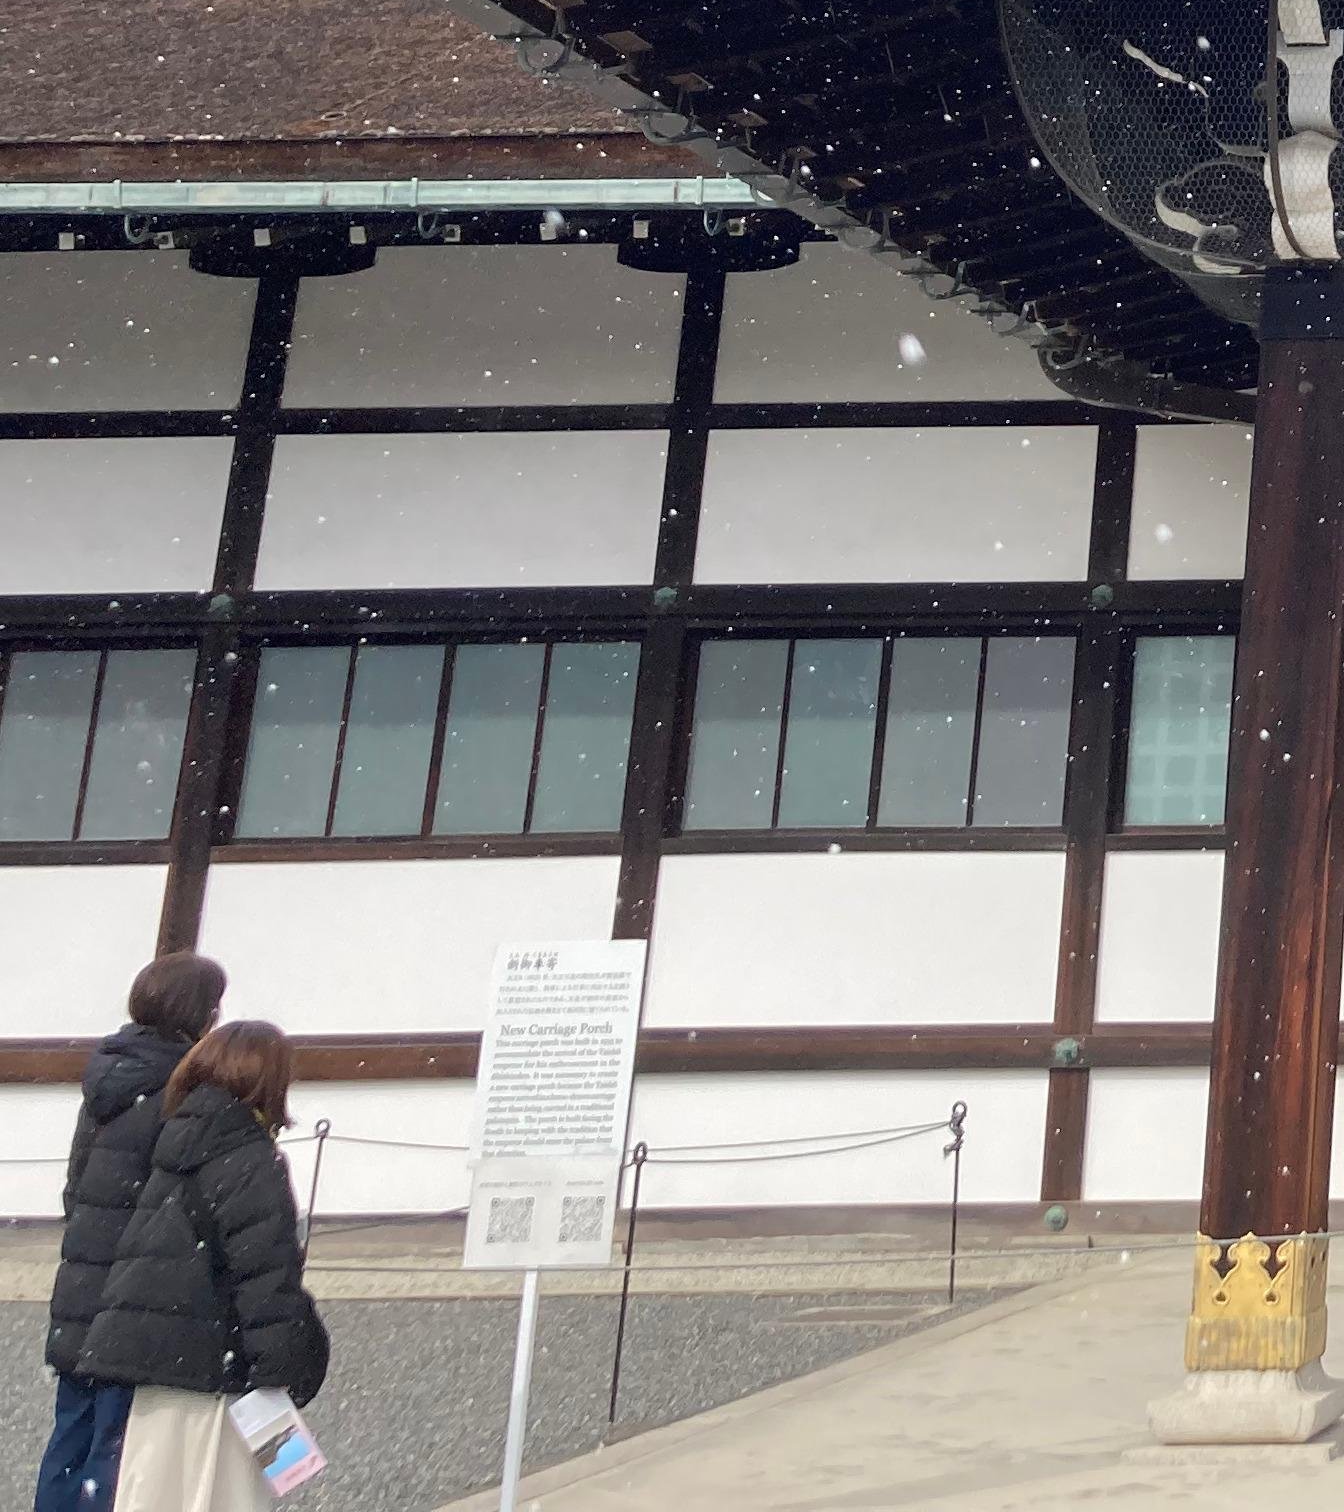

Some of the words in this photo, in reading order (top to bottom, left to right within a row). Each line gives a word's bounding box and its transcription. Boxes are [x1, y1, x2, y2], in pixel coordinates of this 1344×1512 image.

[501, 1024, 526, 1036] New
[529, 1022, 577, 1037] Carriage
[579, 1021, 613, 1034] Porch
